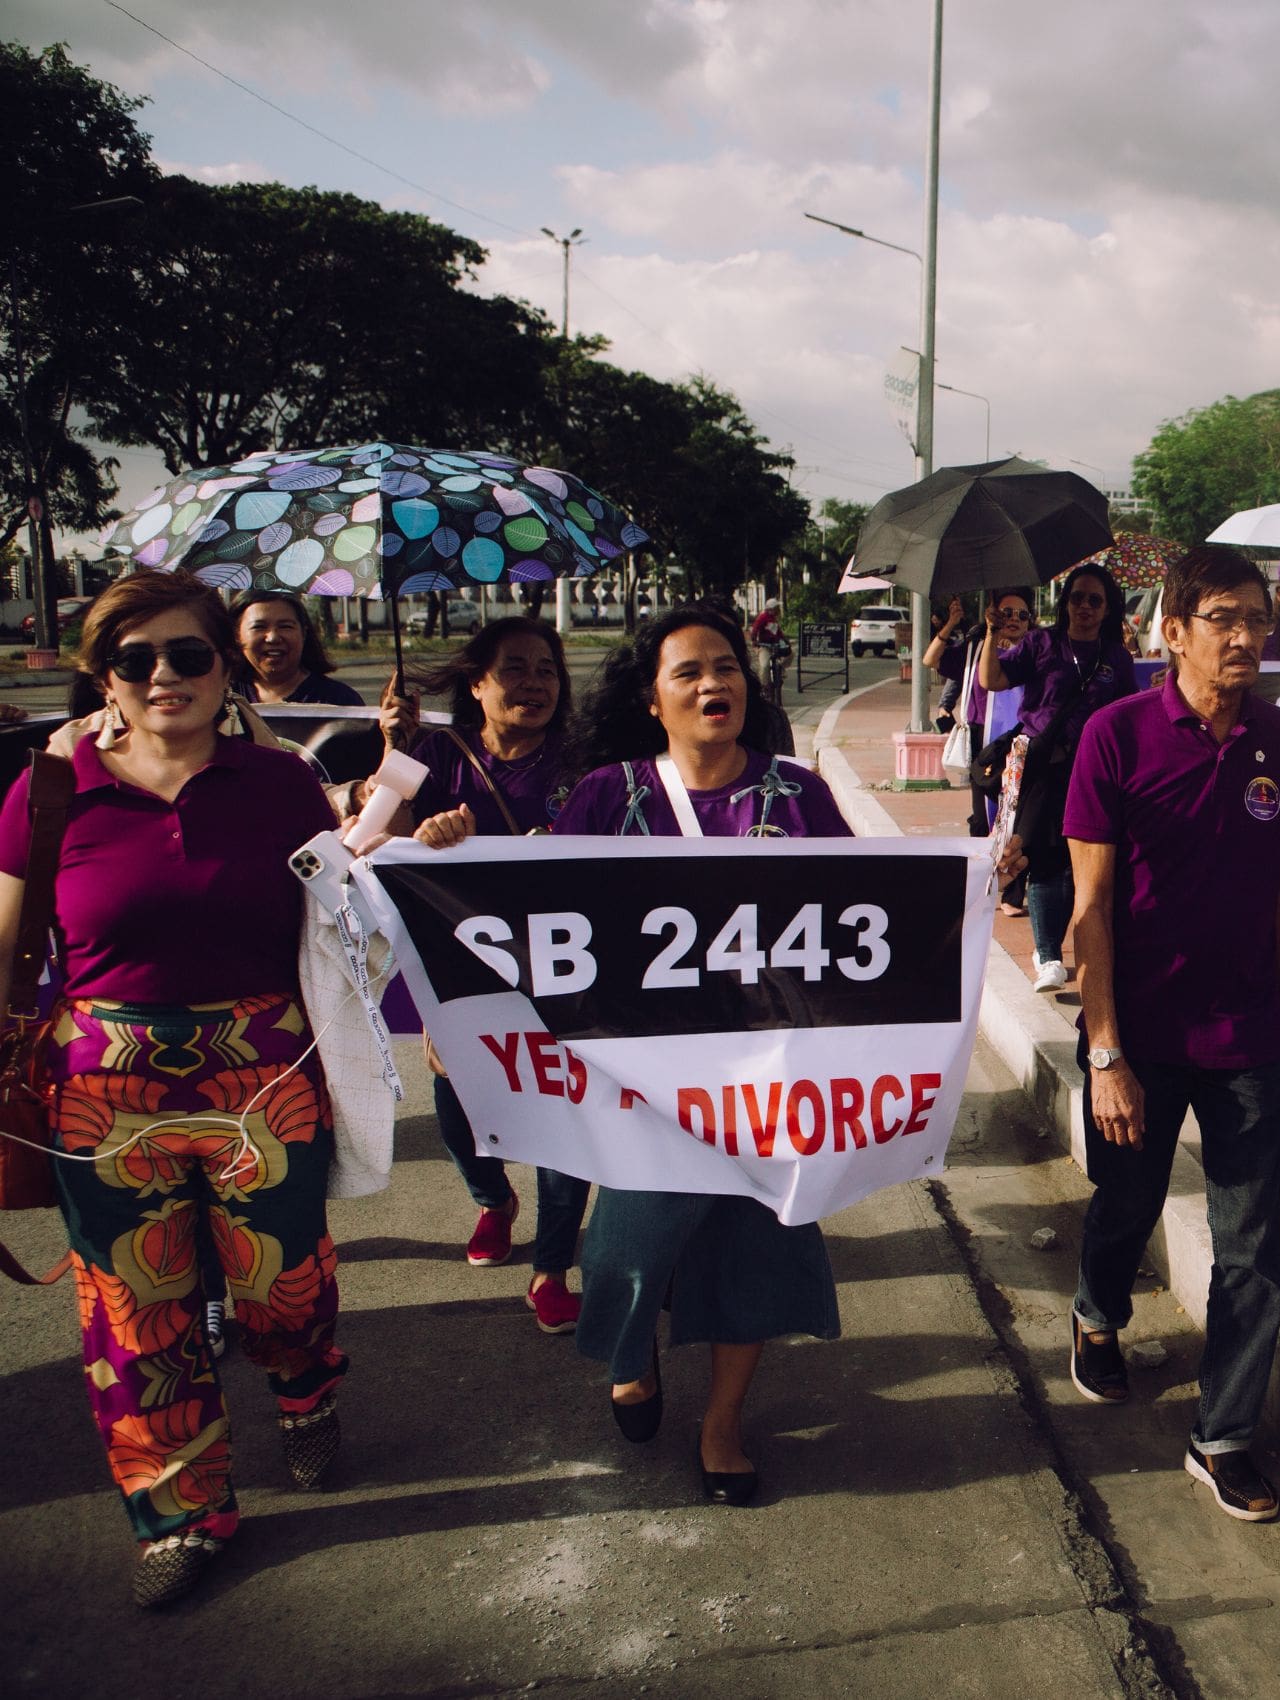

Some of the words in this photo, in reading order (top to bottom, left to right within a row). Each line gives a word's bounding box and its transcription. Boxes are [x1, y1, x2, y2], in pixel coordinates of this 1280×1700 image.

[454, 911, 598, 997] SB
[640, 903, 891, 990] 2443
[478, 1031, 587, 1105] YES
[677, 1073, 942, 1158] DIVORCE
